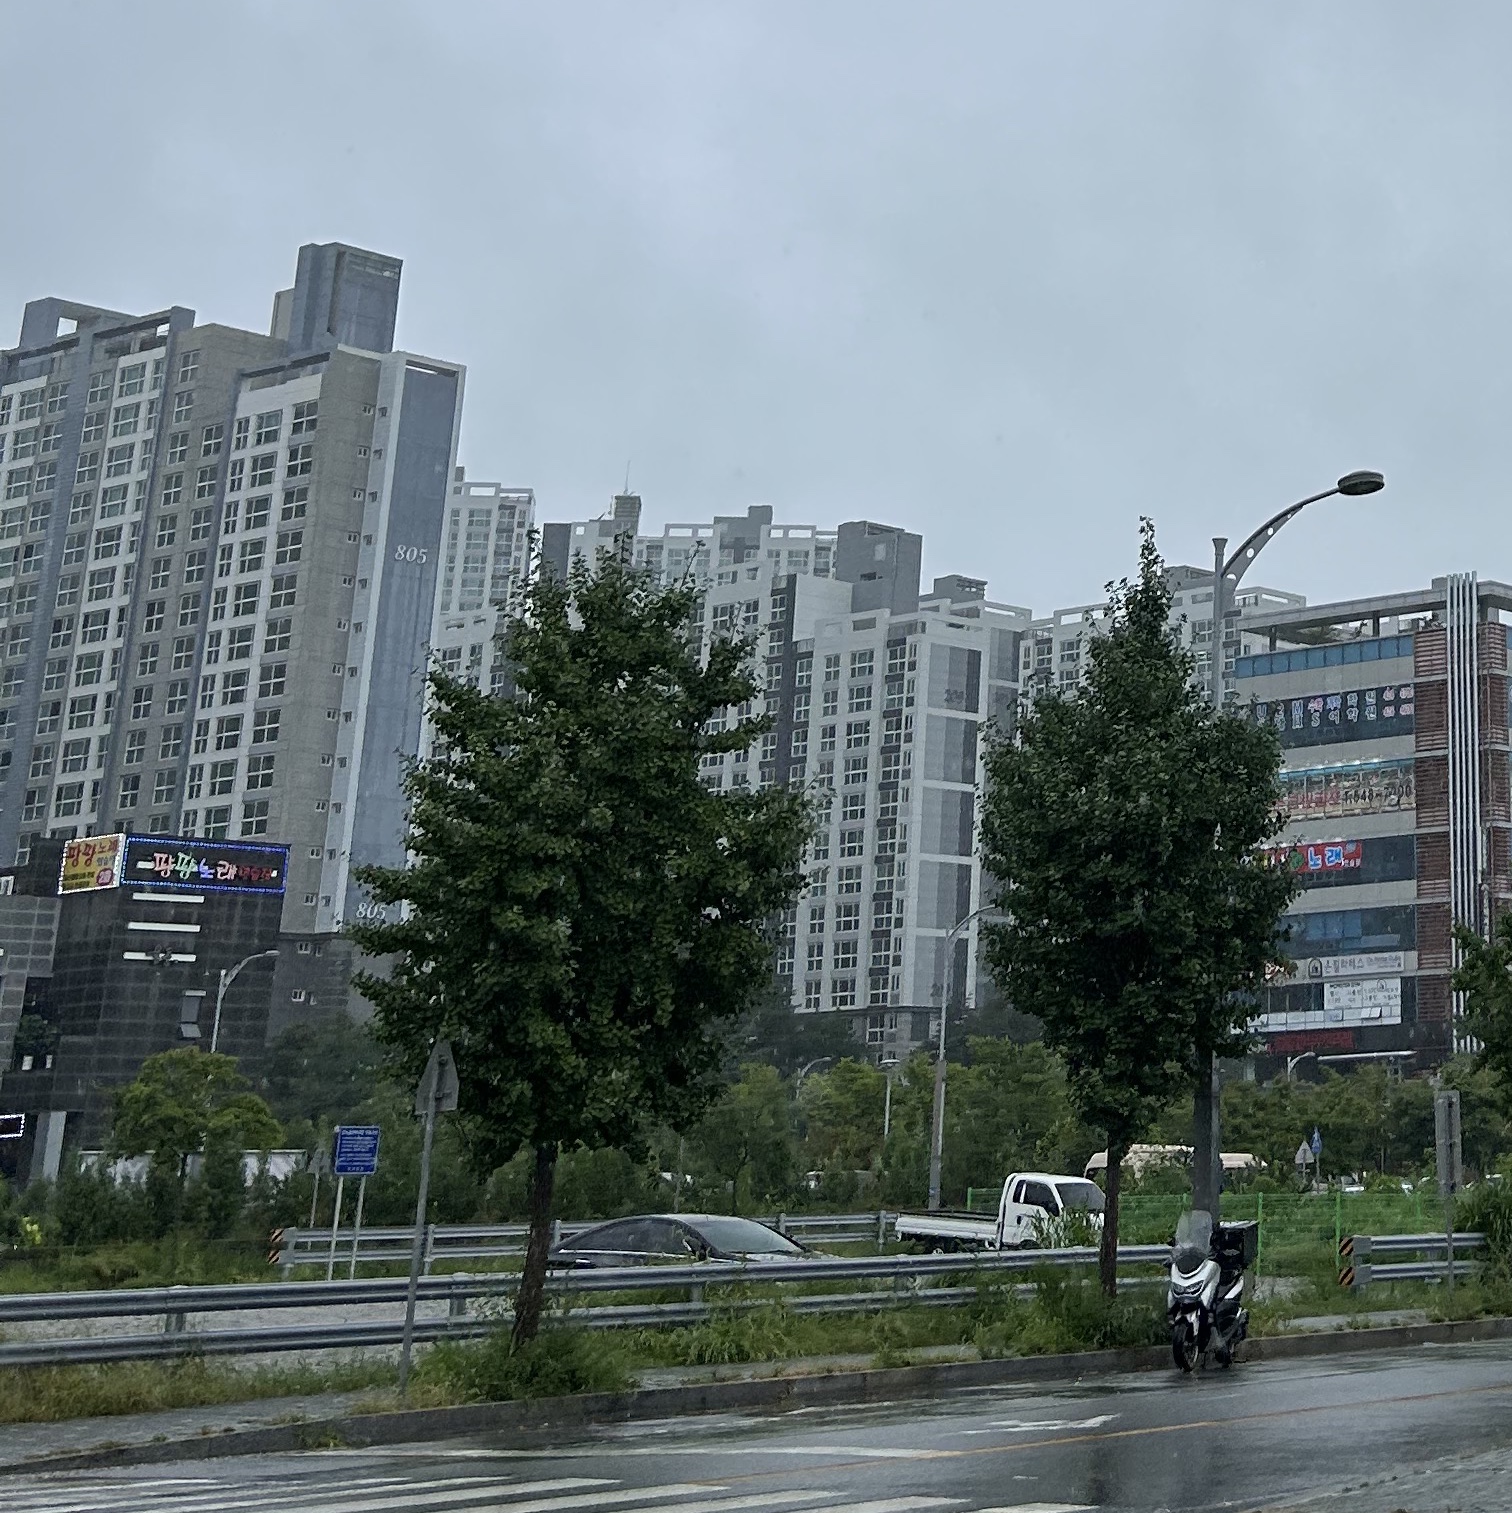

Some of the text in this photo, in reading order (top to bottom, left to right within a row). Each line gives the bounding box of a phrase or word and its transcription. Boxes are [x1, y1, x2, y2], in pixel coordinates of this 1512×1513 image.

[394, 544, 428, 564] 805
[1308, 845, 1344, 870] 노래
[356, 902, 386, 920] 805
